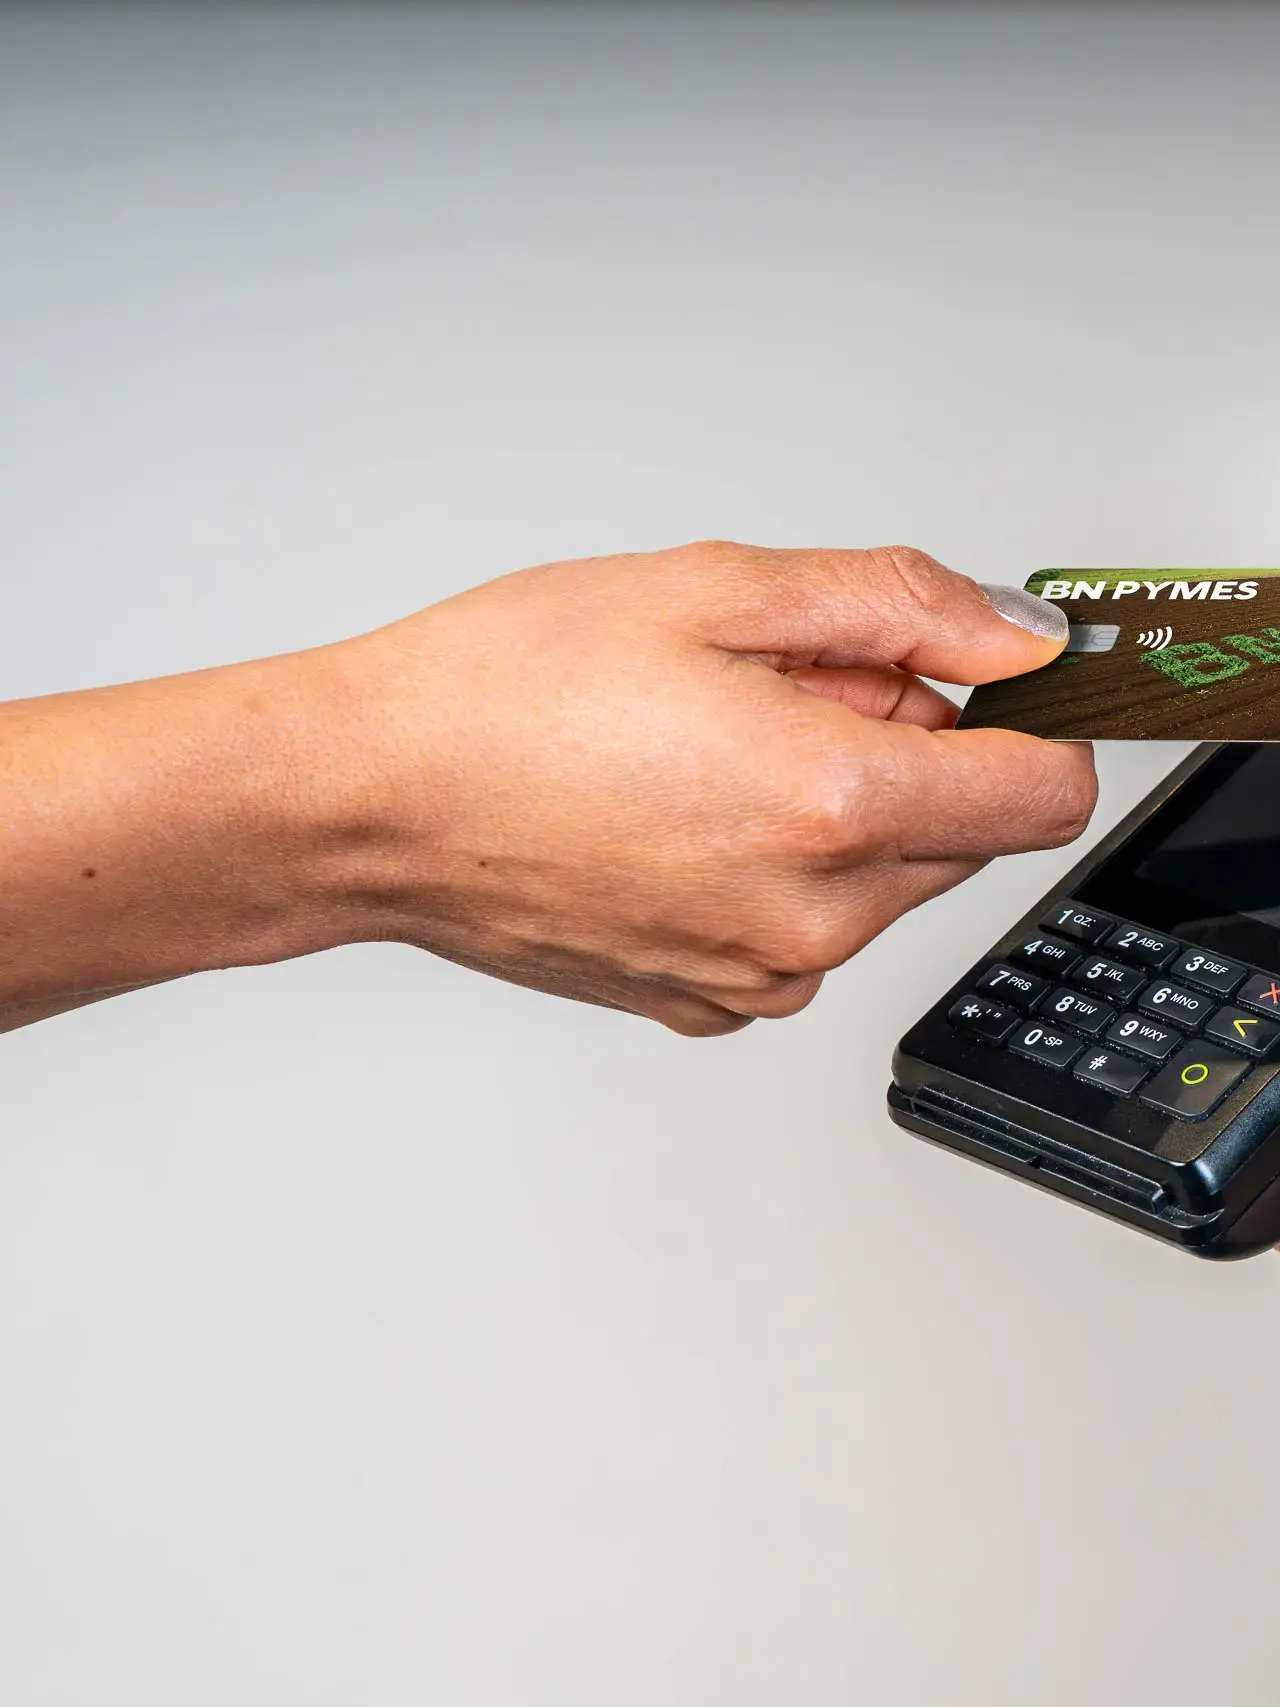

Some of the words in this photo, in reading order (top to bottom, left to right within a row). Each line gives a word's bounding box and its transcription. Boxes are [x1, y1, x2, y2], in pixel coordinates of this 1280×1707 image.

[1041, 580, 1107, 600] BN
[1111, 580, 1260, 600] PYMES
[1057, 909, 1074, 925] 1
[1023, 940, 1044, 956] 4
[1042, 945, 1066, 959] GHI
[1117, 931, 1139, 948] 2
[1137, 937, 1164, 951] ABC
[1086, 962, 1108, 979] 5
[1104, 968, 1125, 982] JKL
[1185, 956, 1205, 972] 3
[1203, 961, 1229, 975] DEF
[989, 970, 1011, 987] 7
[1007, 976, 1032, 991] PRS
[1055, 996, 1075, 1012] 8
[1073, 1001, 1098, 1015] TUV
[1152, 987, 1172, 1004] 6
[1170, 993, 1199, 1010] MNO
[1024, 1029, 1043, 1045] 0
[1119, 1020, 1139, 1036] 9
[1139, 1025, 1167, 1042] WXY
[1088, 1055, 1108, 1070] #
